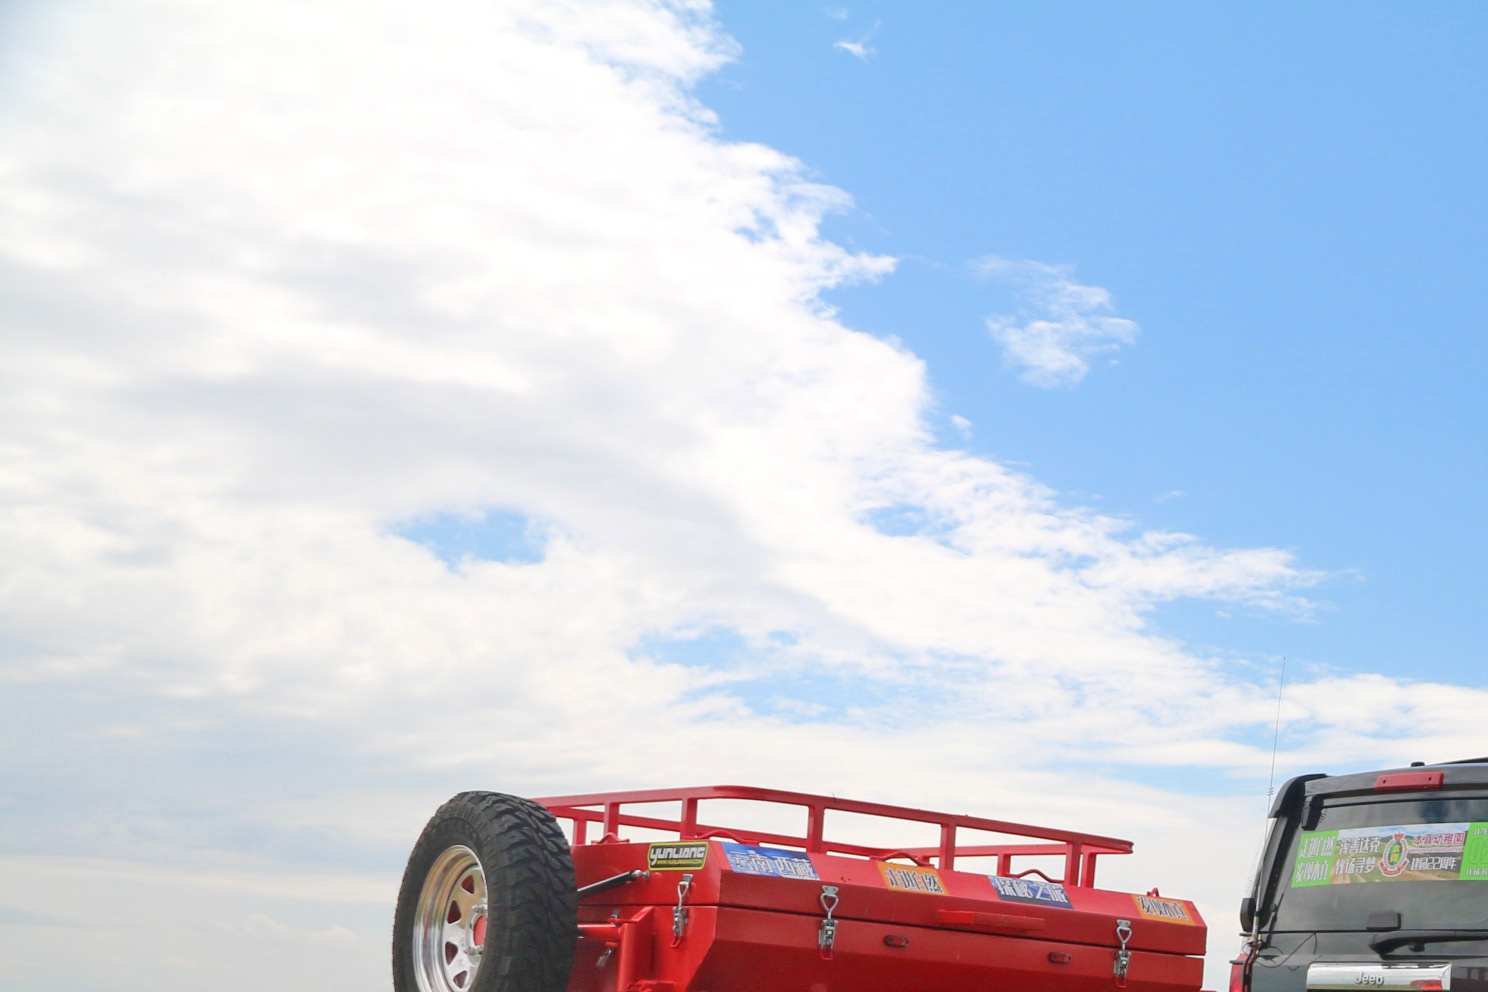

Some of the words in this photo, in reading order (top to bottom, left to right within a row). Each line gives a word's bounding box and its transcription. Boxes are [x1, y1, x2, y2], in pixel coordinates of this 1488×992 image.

[1338, 836, 1381, 855] 浑善达克
[730, 850, 774, 873] 云南
[771, 854, 816, 878] 西藏
[1335, 856, 1377, 876] 牧场寻梦
[884, 867, 944, 894] 走进自然
[994, 876, 1069, 903] 探秘之旅
[1354, 972, 1385, 987] Jeep
